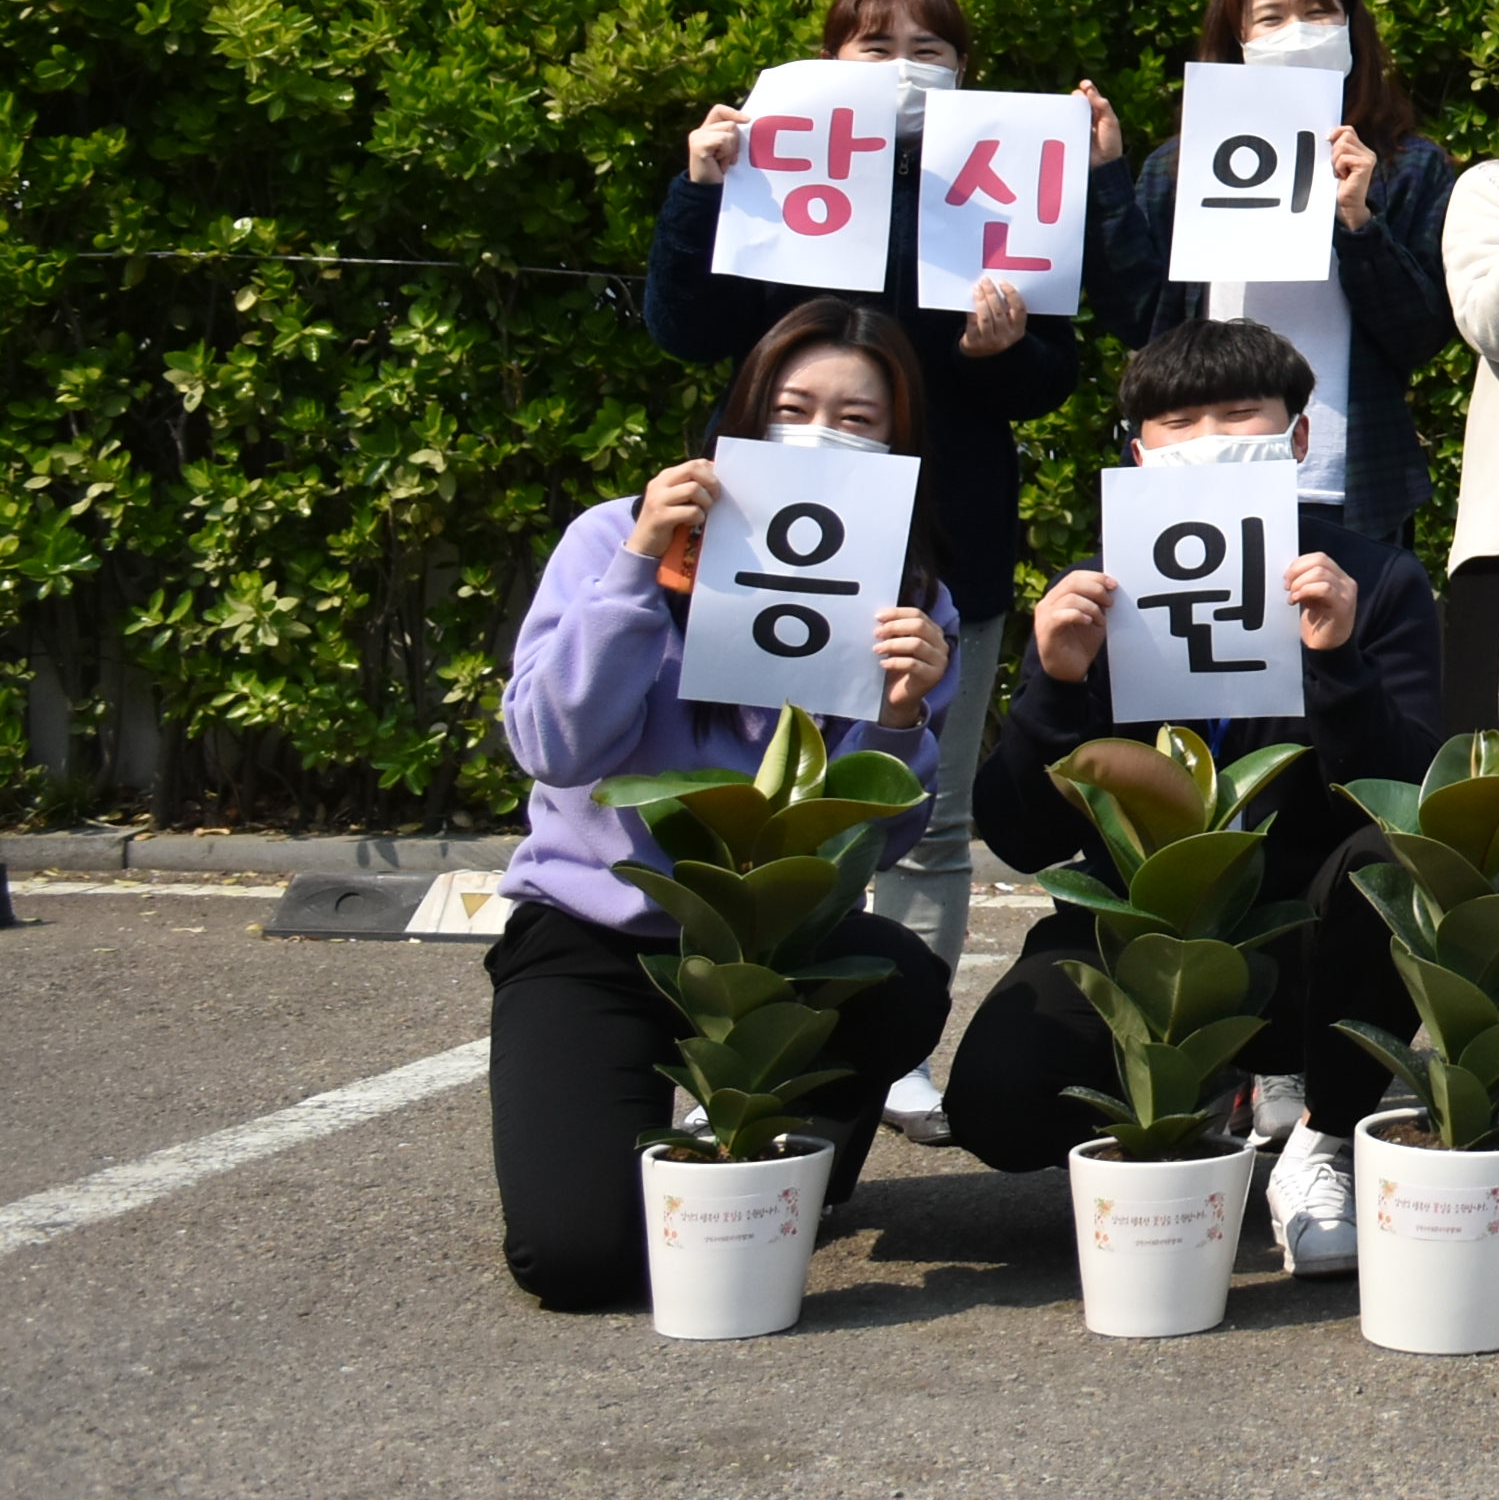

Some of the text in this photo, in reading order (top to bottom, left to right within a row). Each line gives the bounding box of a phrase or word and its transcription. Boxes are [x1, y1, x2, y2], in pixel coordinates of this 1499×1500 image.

[749, 107, 886, 237] 당
[945, 138, 1066, 272] 신
[1200, 130, 1317, 214] 의
[734, 502, 860, 658] 응
[1136, 516, 1267, 674] 원
